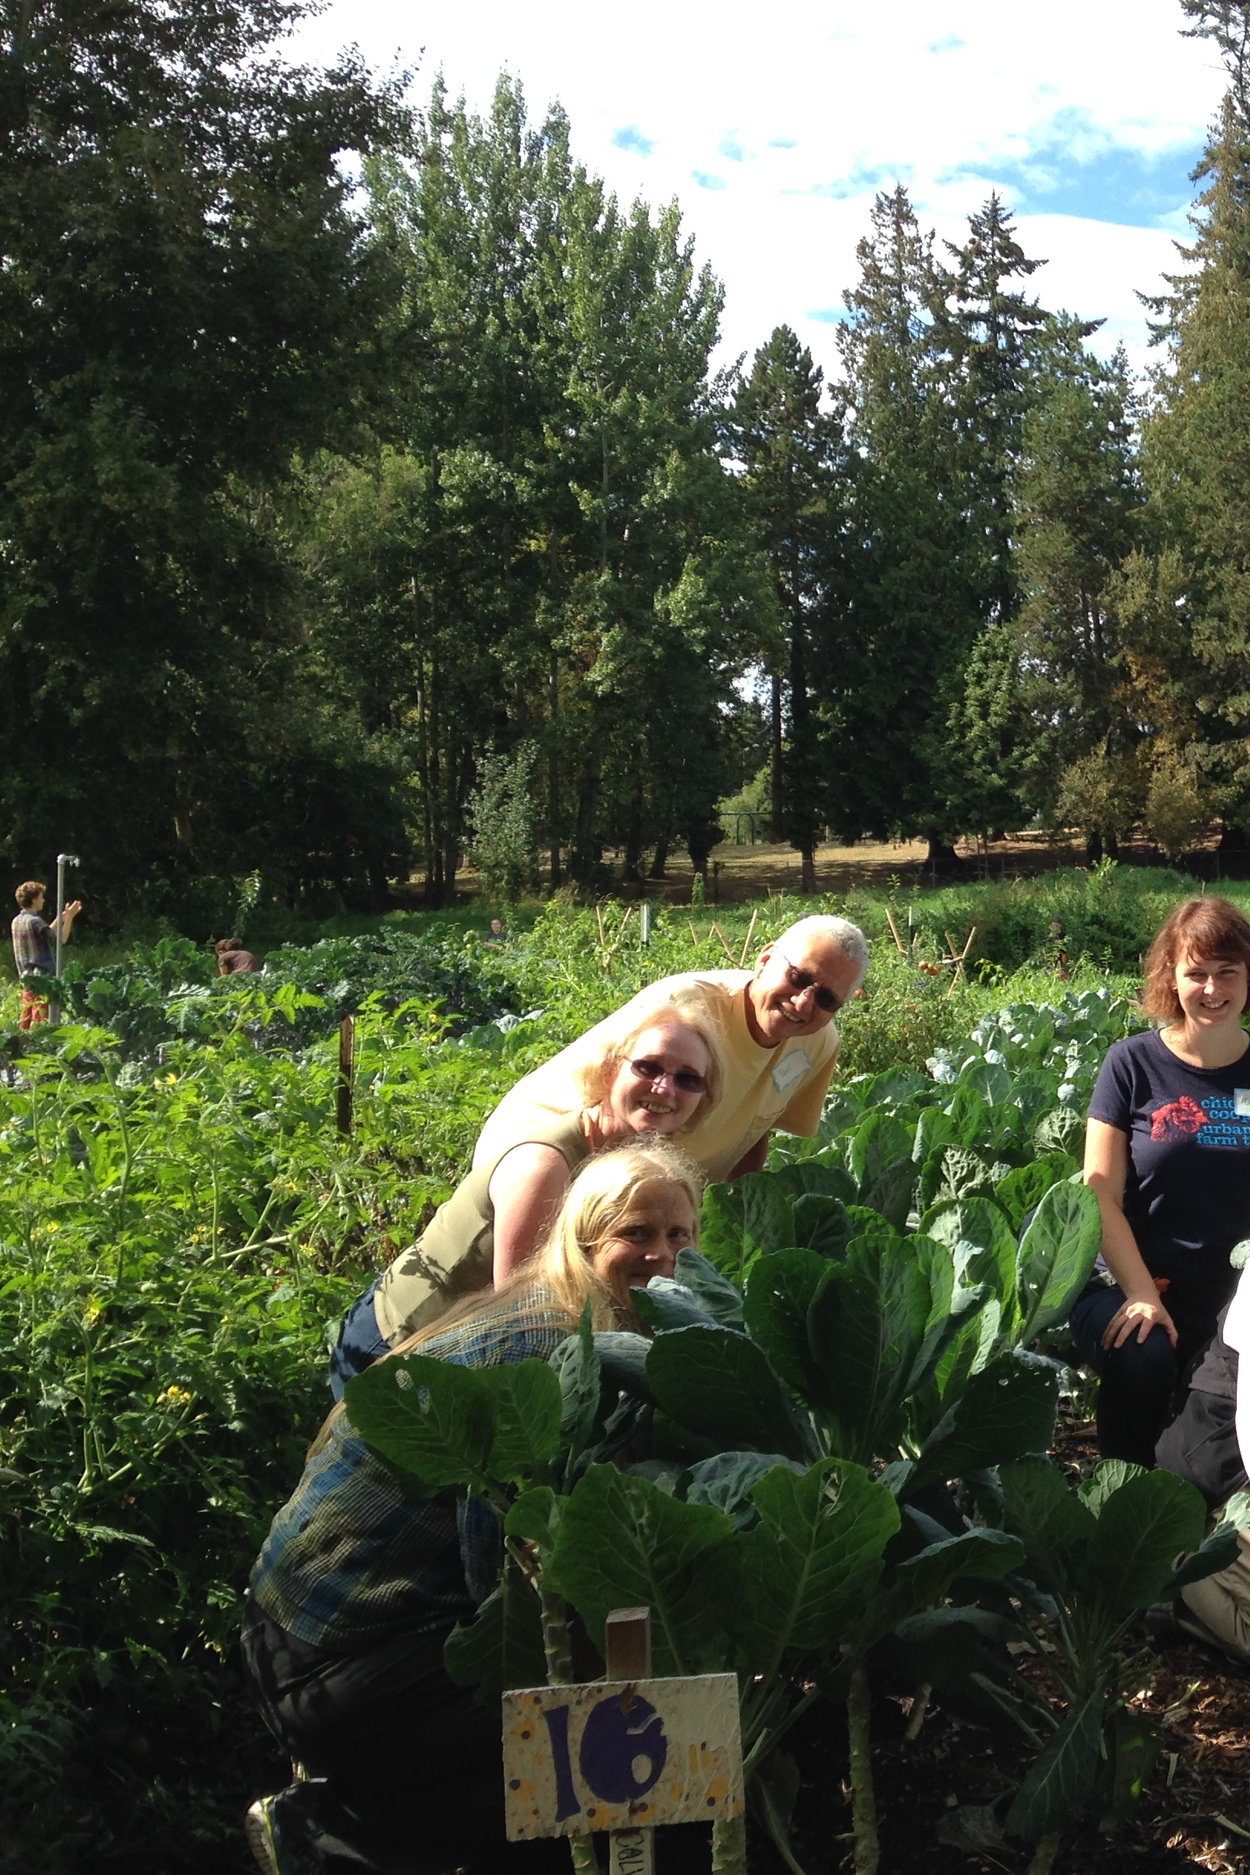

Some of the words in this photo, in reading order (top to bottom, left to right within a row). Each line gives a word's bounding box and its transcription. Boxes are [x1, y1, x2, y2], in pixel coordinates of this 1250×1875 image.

[1201, 1096, 1236, 1109] chic
[1196, 1132, 1238, 1146] farm
[543, 1695, 668, 1823] 16
[615, 1833, 645, 1875] CAL
